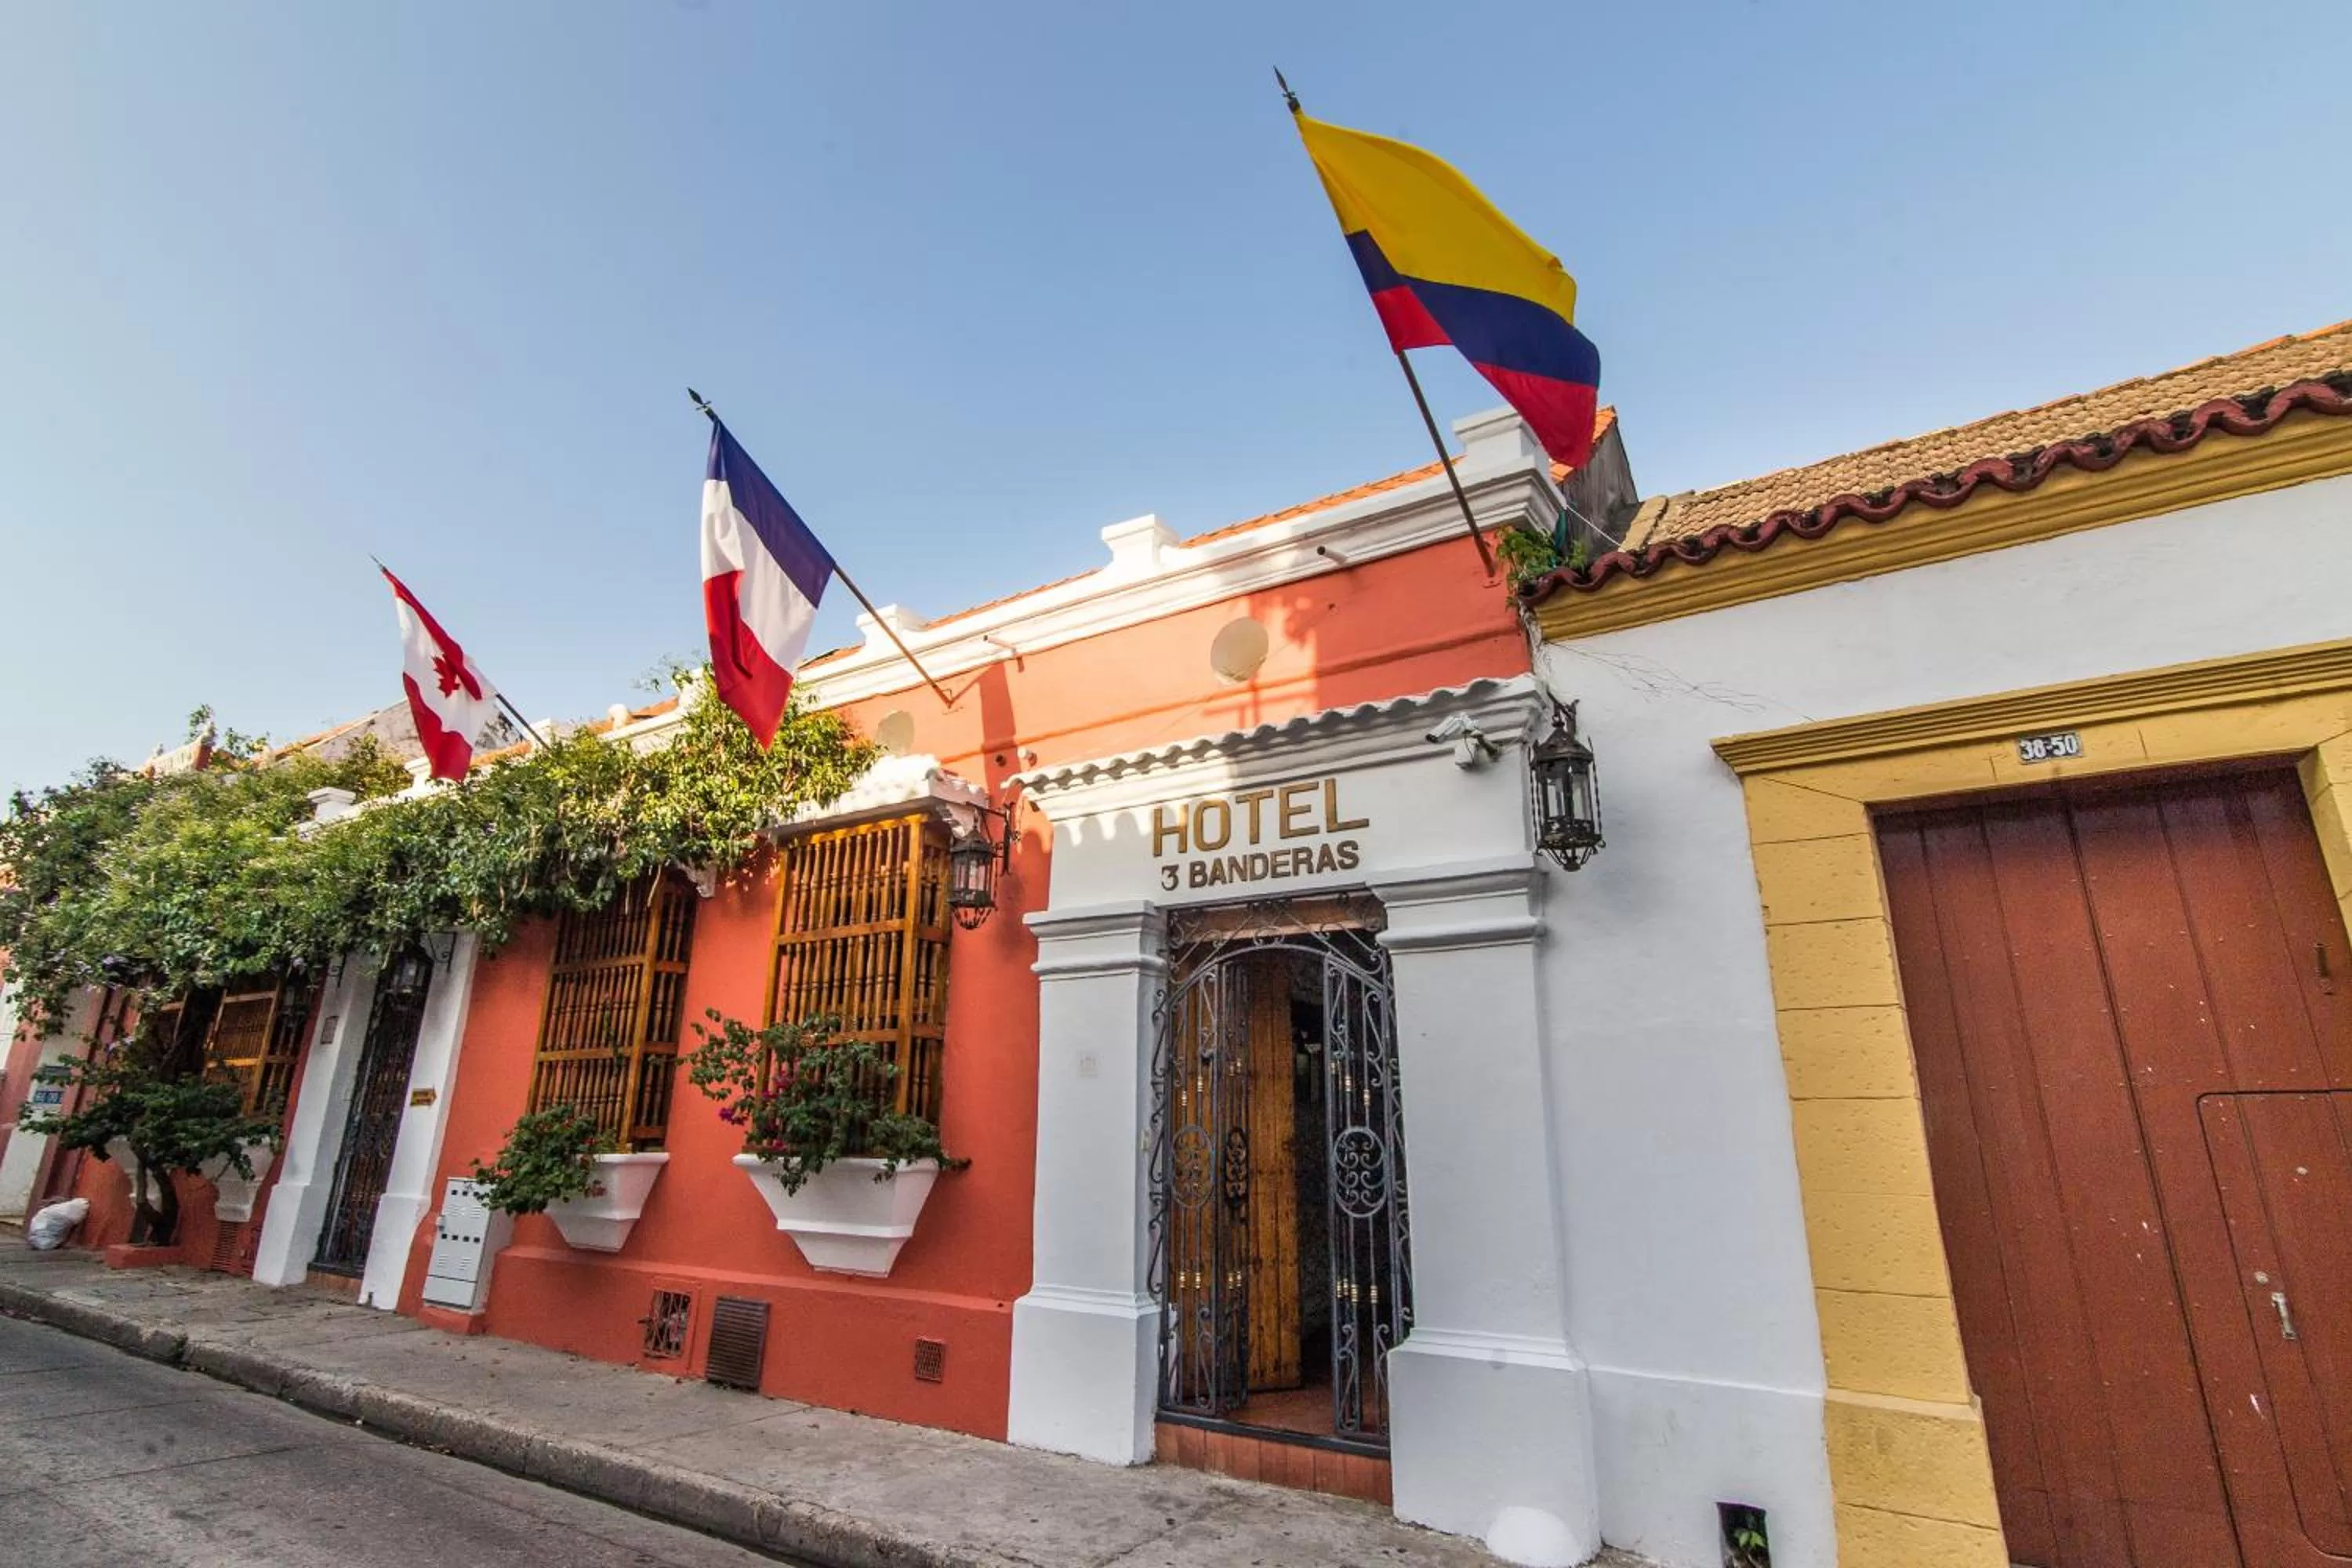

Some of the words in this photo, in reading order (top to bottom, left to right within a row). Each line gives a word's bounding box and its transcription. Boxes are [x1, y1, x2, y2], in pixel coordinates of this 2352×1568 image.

[1152, 778, 1370, 858] HOTEL
[1161, 864, 1179, 891] 3
[1189, 840, 1359, 888] BANDERAS
